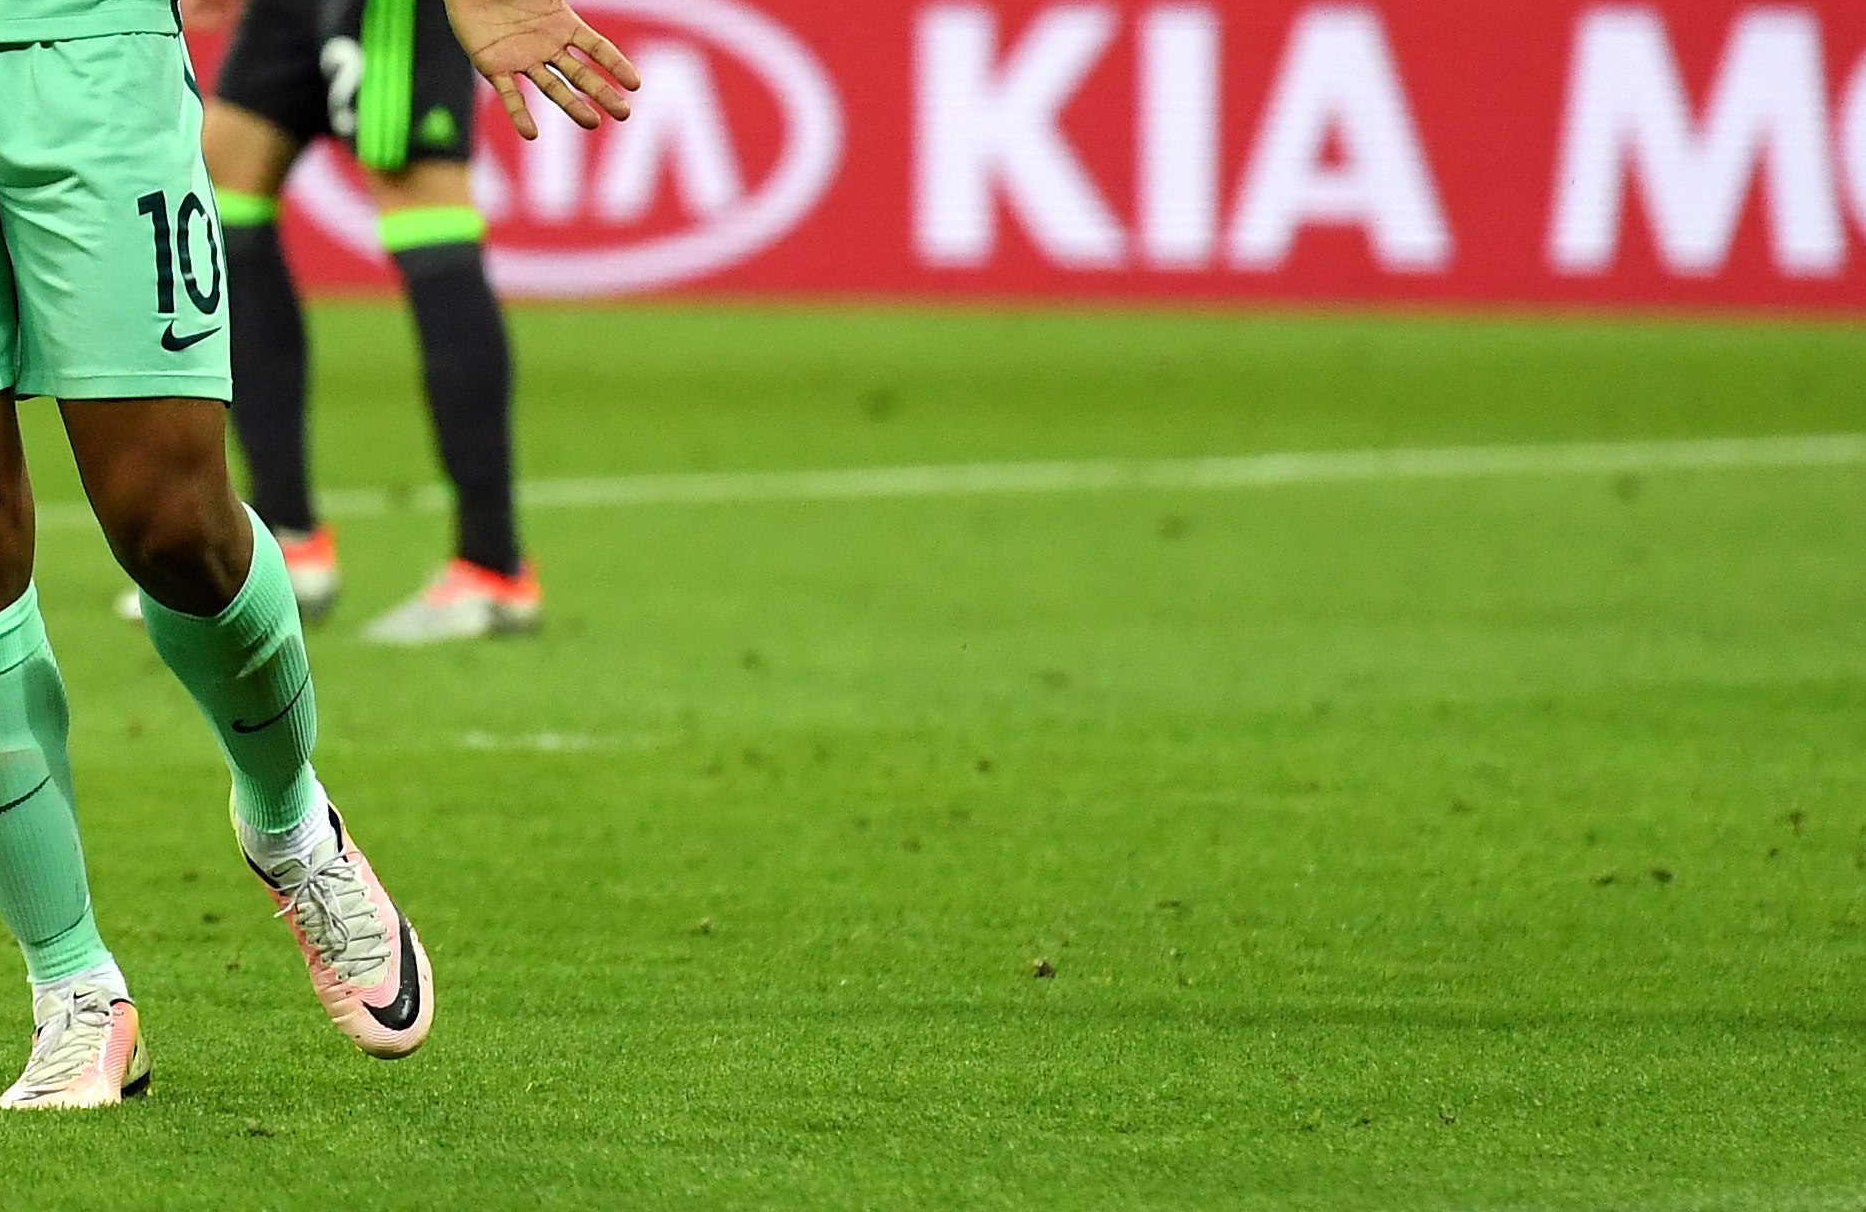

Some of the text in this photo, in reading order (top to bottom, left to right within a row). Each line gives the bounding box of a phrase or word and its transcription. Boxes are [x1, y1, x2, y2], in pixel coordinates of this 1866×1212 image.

[467, 42, 740, 222] IA
[914, 3, 1866, 274] KIA M
[137, 190, 220, 314] 10
